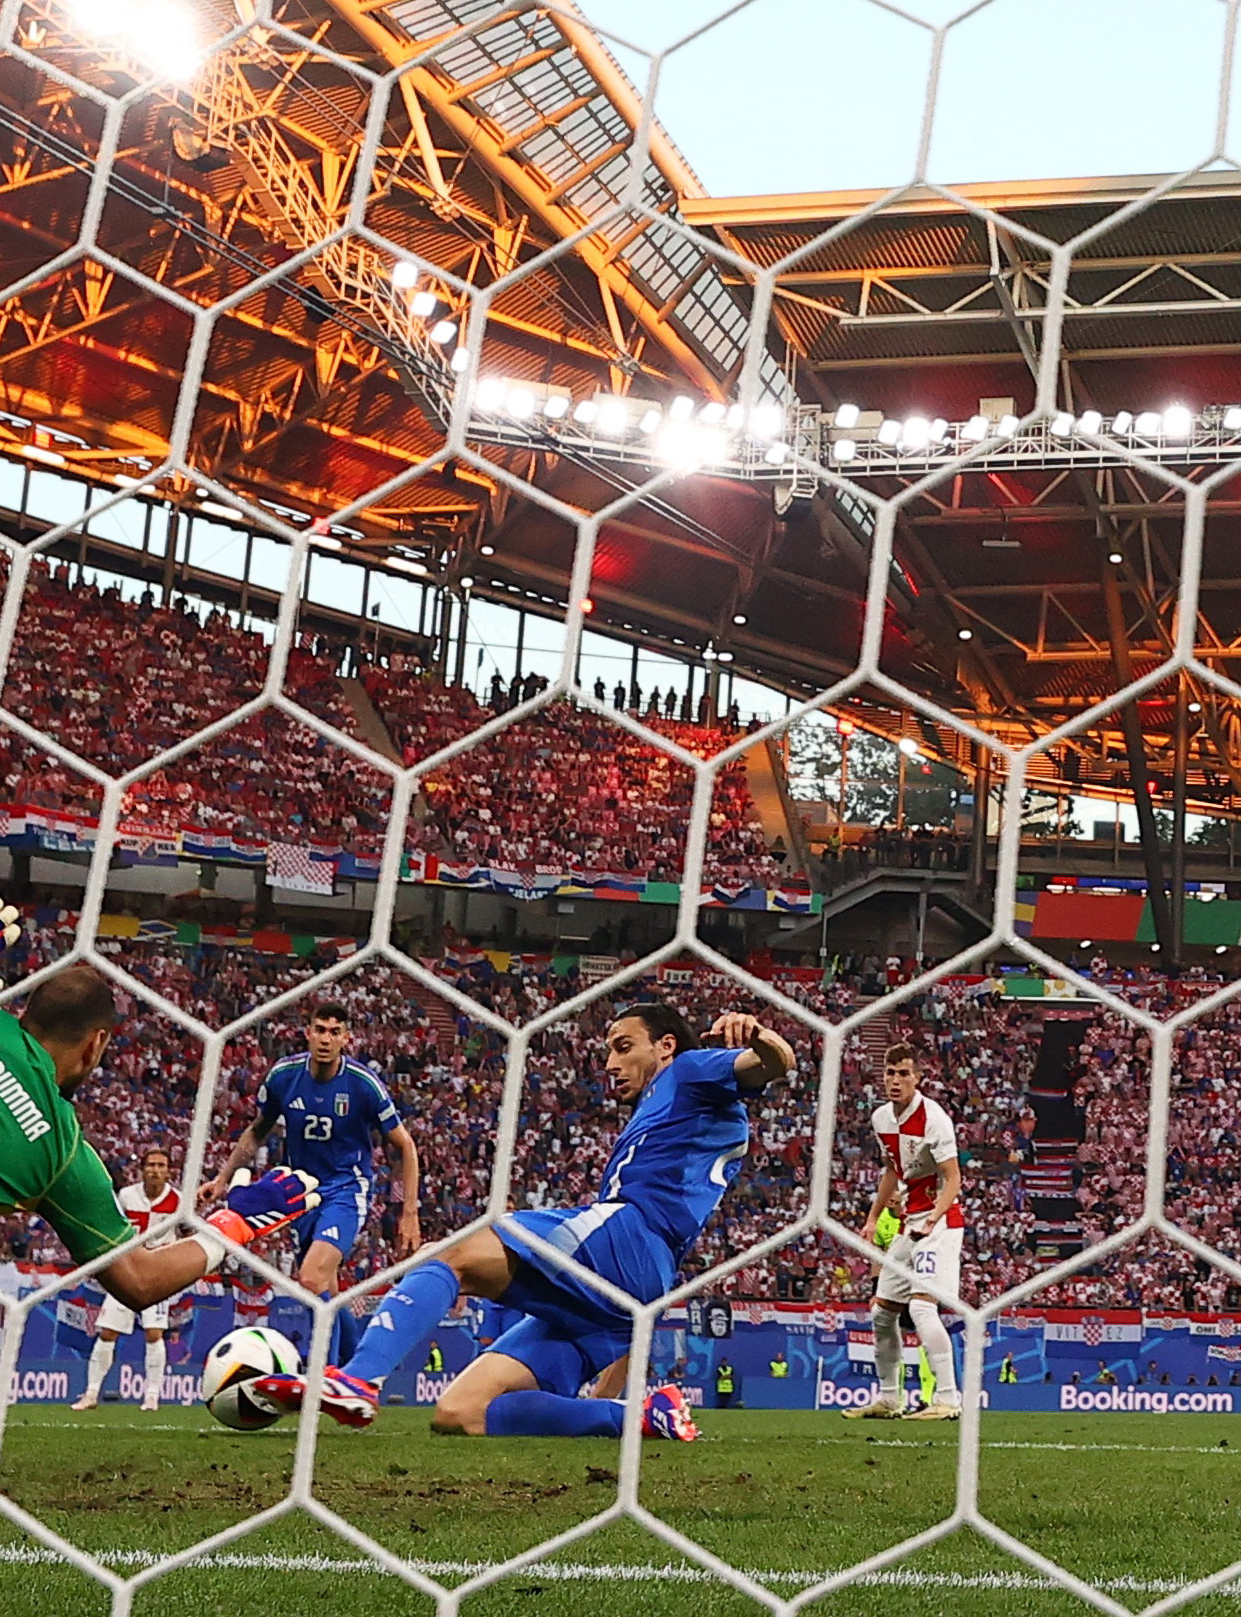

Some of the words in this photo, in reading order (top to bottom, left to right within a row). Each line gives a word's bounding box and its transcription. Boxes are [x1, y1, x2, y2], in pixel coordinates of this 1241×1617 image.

[304, 1114, 333, 1141] 23
[915, 1251, 937, 1274] 25
[1060, 1384, 1233, 1414] Booking.com
